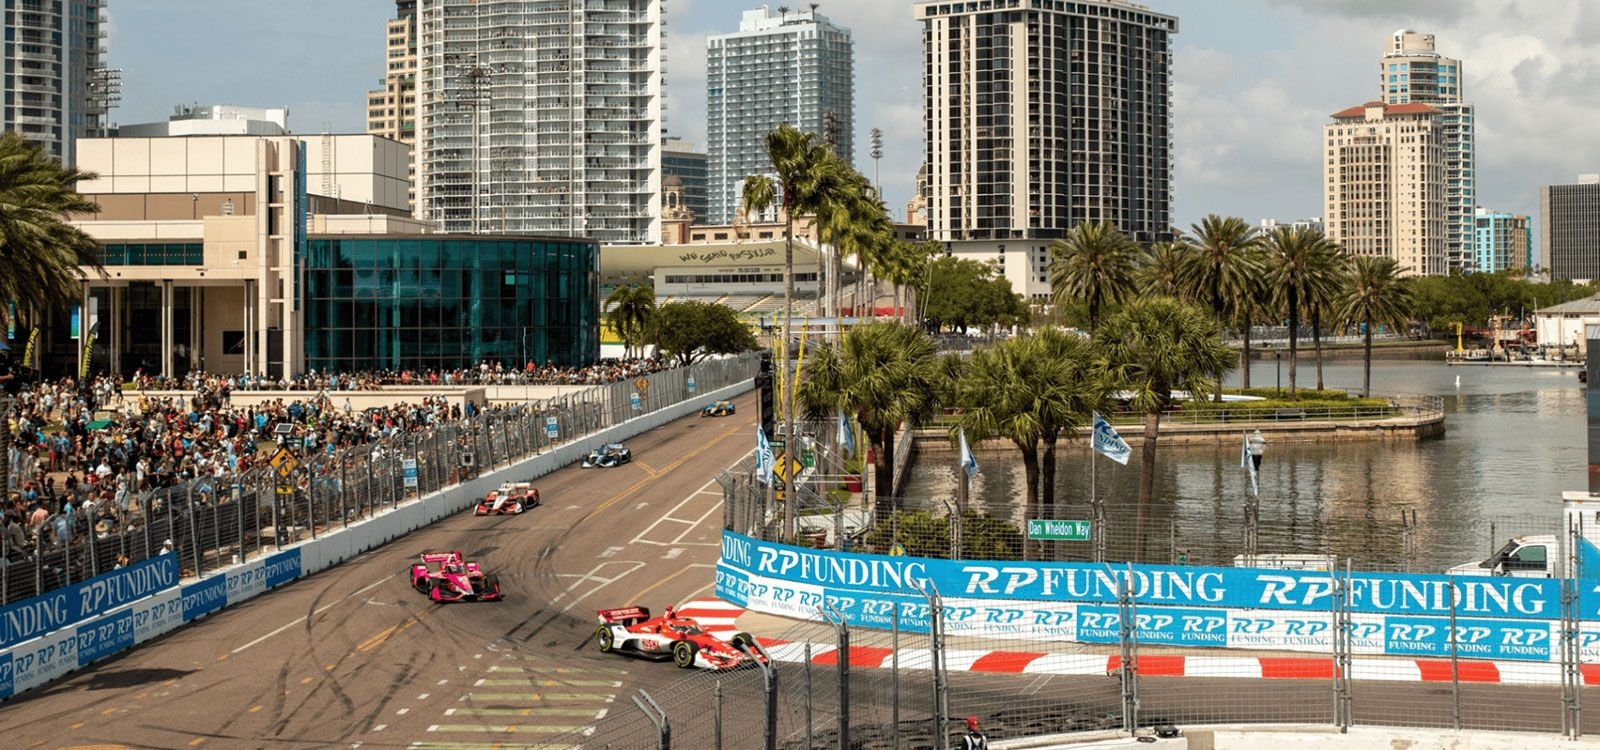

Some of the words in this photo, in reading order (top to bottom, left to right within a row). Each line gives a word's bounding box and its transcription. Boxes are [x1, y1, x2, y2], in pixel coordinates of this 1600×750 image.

[1030, 522, 1042, 535] Dan
[1045, 521, 1072, 535] Wheldon
[1076, 521, 1090, 540] Way
[750, 582, 768, 597] RP
[772, 586, 794, 602] RP
[799, 590, 822, 606] RP
[135, 609, 149, 628] RP
[152, 603, 165, 621] RP
[168, 597, 181, 615] RP
[826, 595, 855, 611] RP
[861, 599, 894, 615] RP
[900, 602, 930, 619] RP
[942, 605, 976, 621] RP
[984, 608, 1024, 623] RP
[1033, 610, 1073, 625] RP
[900, 617, 931, 628] FUNDIN
[983, 623, 1025, 633] FUNDING
[1031, 625, 1074, 636] FUNDING
[1080, 612, 1120, 628] RP
[1131, 614, 1174, 631] RP
[1181, 615, 1225, 632] RP
[1231, 617, 1275, 633] RP
[1284, 620, 1328, 636] RP
[79, 629, 96, 650] RP
[98, 622, 115, 643] RP
[117, 616, 132, 635] RP
[1181, 632, 1225, 642] FUNDING
[1231, 635, 1275, 644] FUNDING
[1283, 637, 1328, 646] FUNDING
[1390, 624, 1435, 640] RP
[1444, 626, 1491, 643] RP
[1500, 628, 1548, 645] RP
[15, 653, 34, 675] RP
[37, 645, 55, 666] RP
[58, 636, 76, 657] RP
[1389, 642, 1435, 651] FUNDING
[1500, 645, 1548, 655] FUNDING
